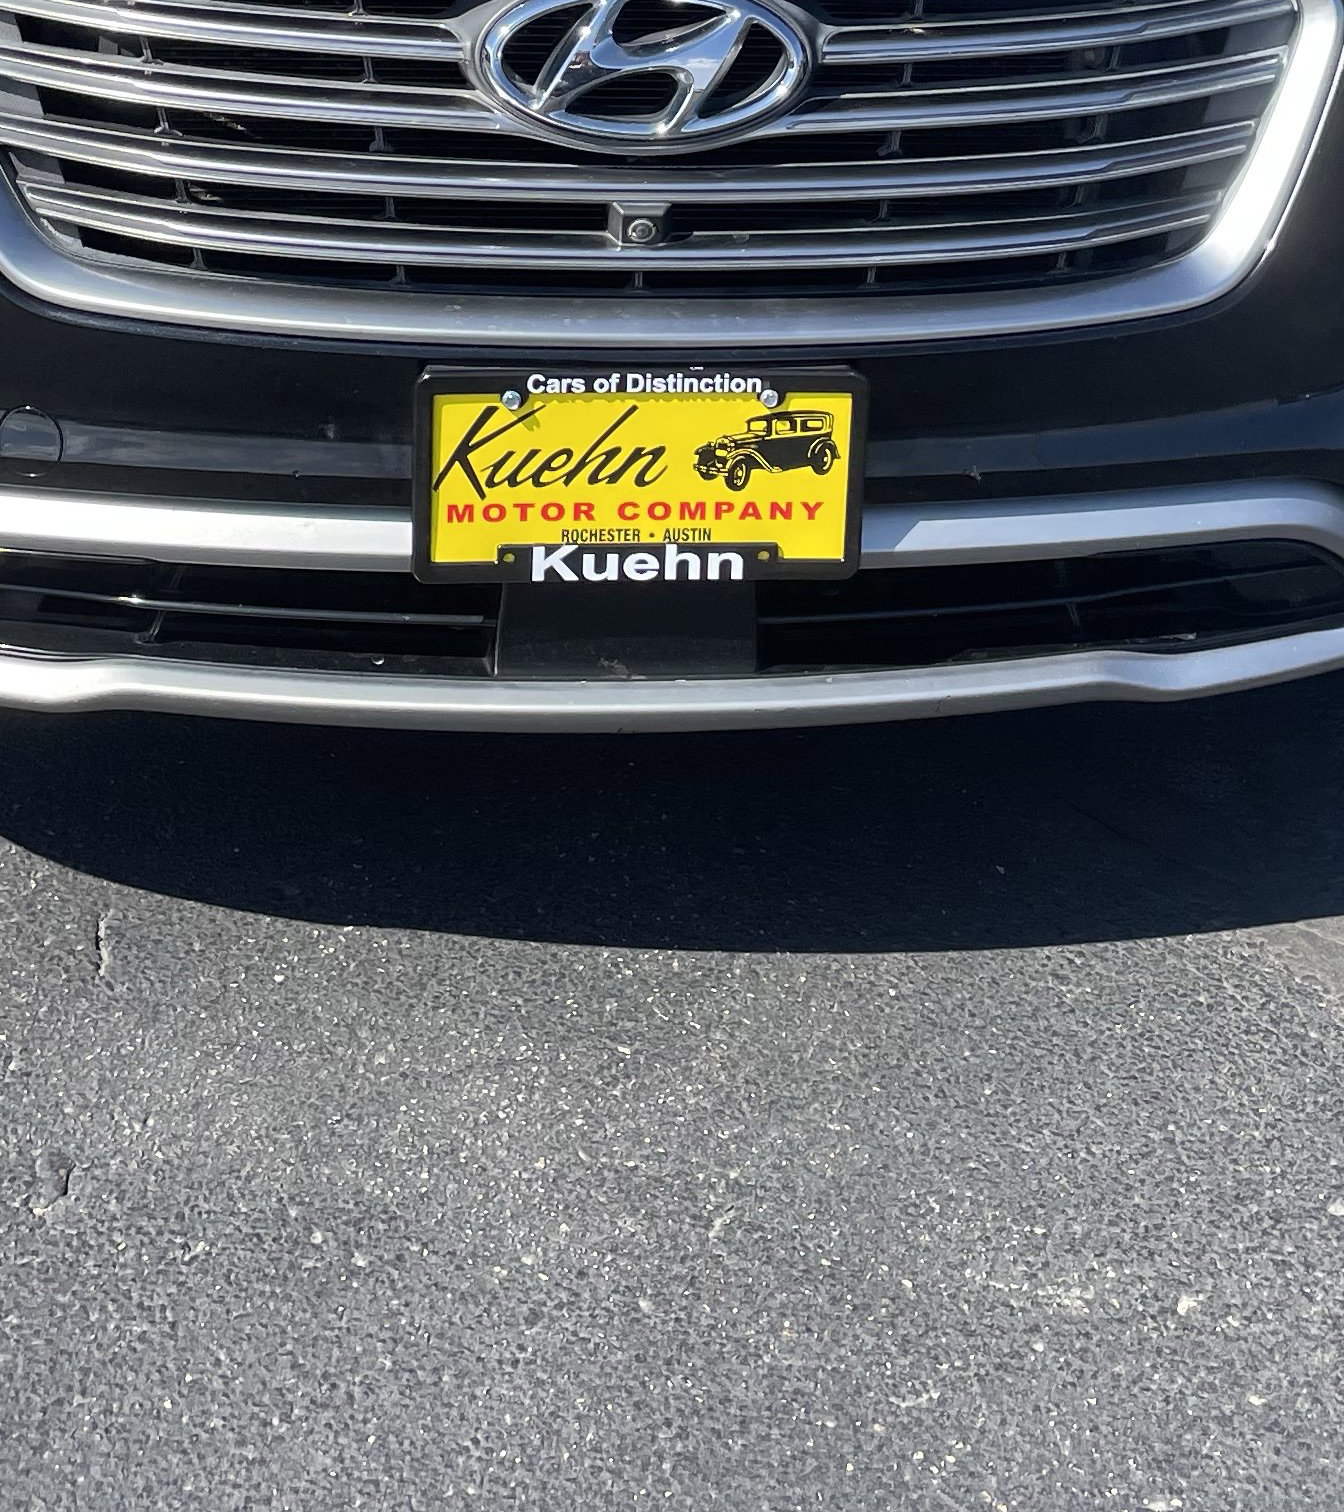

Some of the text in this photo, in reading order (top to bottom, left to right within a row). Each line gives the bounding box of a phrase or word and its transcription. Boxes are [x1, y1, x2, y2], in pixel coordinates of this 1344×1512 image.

[526, 372, 762, 394] Cars of Distinction
[432, 404, 668, 501] Kuehn
[447, 501, 825, 523] MOTOR COMPANY
[561, 527, 712, 543] ROCHESTER AUSTIN
[531, 543, 744, 582] Kuehn
